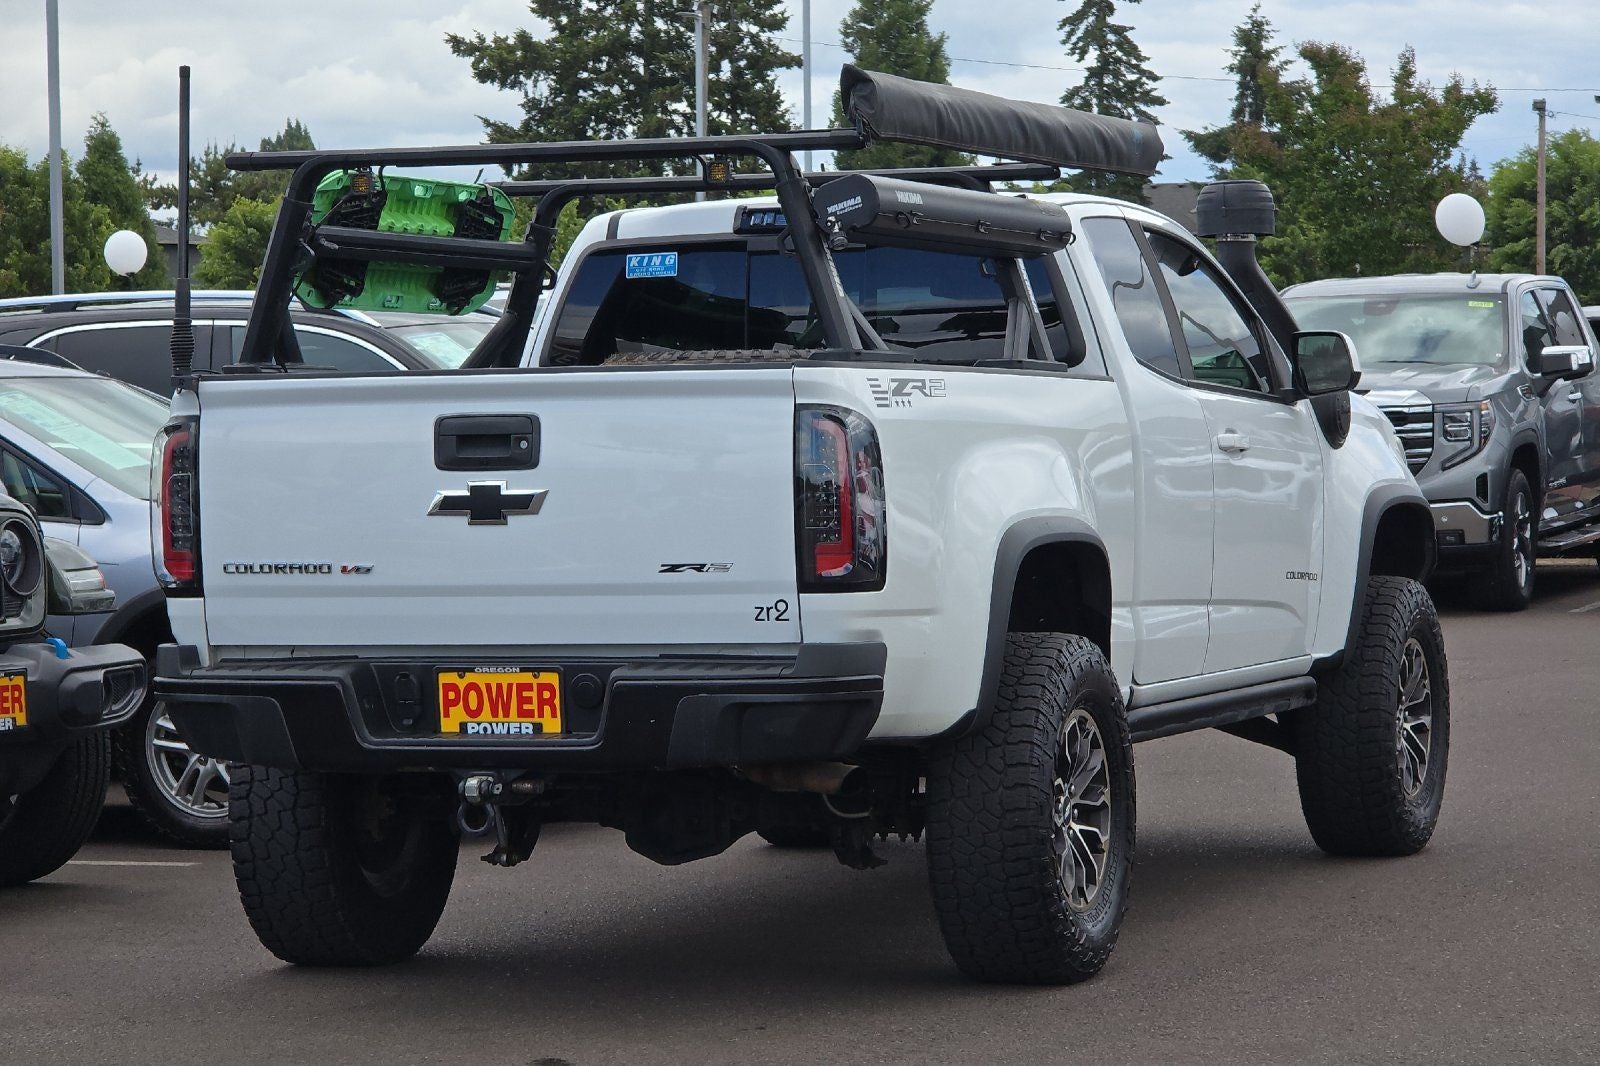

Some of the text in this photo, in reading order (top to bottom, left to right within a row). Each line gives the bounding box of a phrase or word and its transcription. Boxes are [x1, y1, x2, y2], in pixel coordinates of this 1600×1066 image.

[826, 195, 862, 214] YAKIMA
[895, 190, 924, 205] YAKIMA
[629, 255, 675, 267] KING
[890, 378, 946, 397] ZR2
[222, 562, 375, 575] COLORADO V6
[658, 562, 734, 574] ZR2
[1285, 571, 1318, 581] COLORADO
[754, 598, 790, 622] zr2
[0, 684, 23, 714] ER
[441, 681, 558, 719] POWER
[466, 722, 534, 735] POWER
